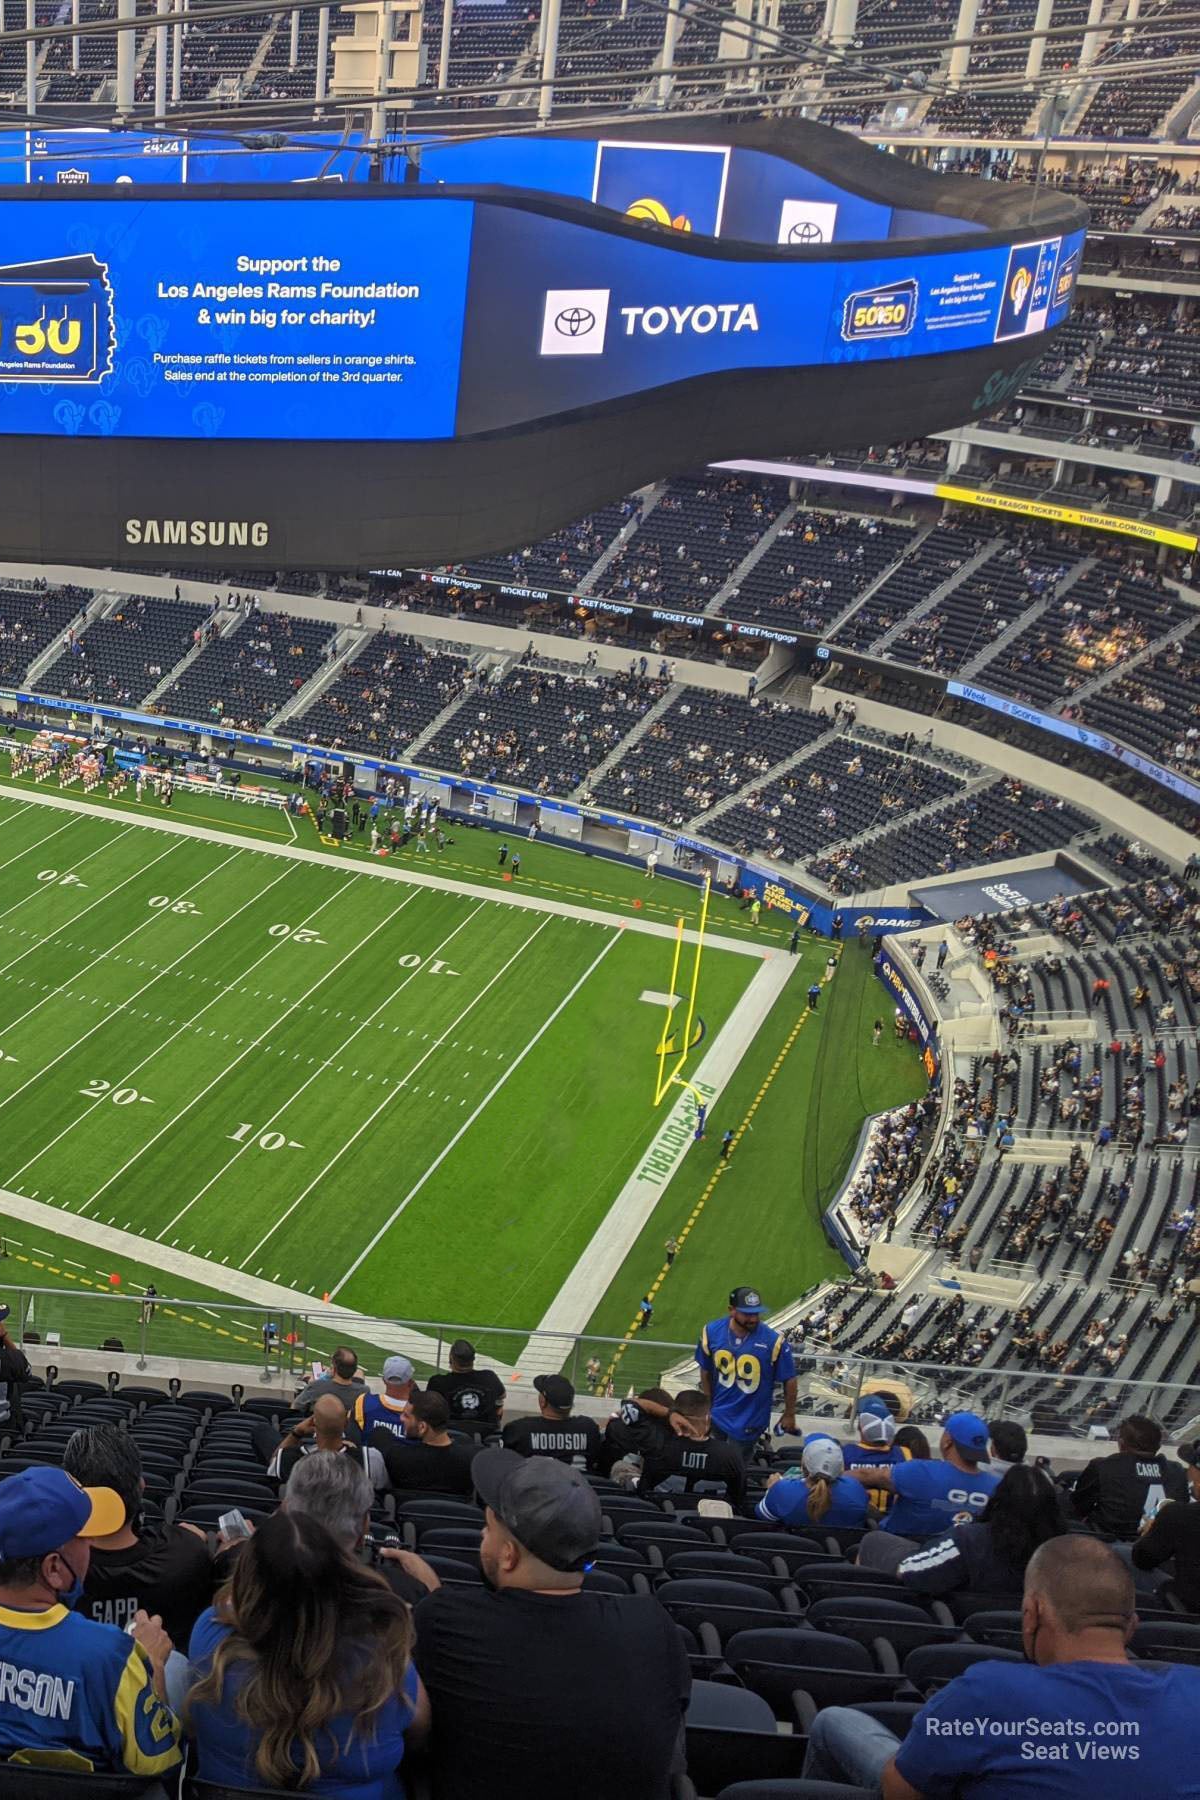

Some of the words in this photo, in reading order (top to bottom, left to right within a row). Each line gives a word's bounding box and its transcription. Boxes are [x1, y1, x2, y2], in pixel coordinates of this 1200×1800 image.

[236, 255, 307, 276] Support
[312, 256, 341, 272] the
[157, 282, 189, 298] Los
[192, 282, 263, 302] Angeles
[267, 283, 316, 298] Rams
[321, 283, 420, 298] Foundation
[197, 309, 211, 324] &
[215, 309, 246, 324] win
[250, 309, 277, 328] big
[281, 309, 305, 325] for
[309, 309, 376, 329] charity!
[621, 303, 759, 335] TOYOTA
[853, 307, 879, 327] 50
[882, 304, 906, 324] 50
[0, 361, 23, 370] Angeles
[24, 361, 41, 369] Rams
[42, 361, 76, 369] Foundation
[153, 353, 202, 365] Purchase
[204, 353, 231, 365] raffle
[233, 353, 268, 365] tickets
[269, 353, 295, 365] from
[296, 354, 331, 365] sellers
[333, 354, 342, 365] in
[344, 356, 382, 368] orange
[384, 354, 417, 365] shirts.
[164, 370, 193, 381] Sales
[194, 370, 215, 382] end
[217, 371, 228, 382] at
[229, 371, 246, 382] the
[248, 371, 307, 384] completion
[309, 371, 321, 382] of
[322, 371, 340, 382] the
[341, 371, 360, 382] 3rd
[362, 372, 403, 384] quarter.
[976, 495, 997, 505] RAMS
[999, 499, 1029, 511] SEASON
[1031, 504, 1063, 518] TICKETS
[1079, 514, 1157, 537] THERAMS.COM/2021
[126, 519, 269, 547] SAMSUNG
[387, 569, 402, 577] CAN
[421, 574, 450, 584] ROCKET
[450, 577, 482, 590] Mortgage
[500, 586, 530, 598] ROCKET
[531, 591, 548, 600] CAN
[567, 597, 599, 608] ROCKET
[599, 601, 634, 614] Mortgage
[653, 611, 684, 623] ROCKET
[686, 616, 704, 626] CAN
[726, 623, 759, 636] ROCKET
[760, 629, 797, 643] Mortgage
[962, 687, 987, 704] Week
[1011, 705, 1042, 725] Scores
[36, 869, 81, 888] 40
[765, 881, 786, 895] LOS
[148, 895, 196, 915] 30
[763, 894, 791, 913] RAMS
[872, 918, 922, 928] RAMS
[268, 923, 320, 944] 20
[398, 954, 452, 976] 10
[78, 1079, 139, 1106] 20
[225, 1122, 287, 1151] 10
[637, 1116, 696, 1186] FOOTBALL
[714, 1349, 761, 1394] 99
[373, 1419, 407, 1438] DONAL
[530, 1432, 587, 1450] WOODSON
[682, 1451, 708, 1469] LOTT
[1135, 1462, 1161, 1479] CARR
[947, 1488, 990, 1507] GO
